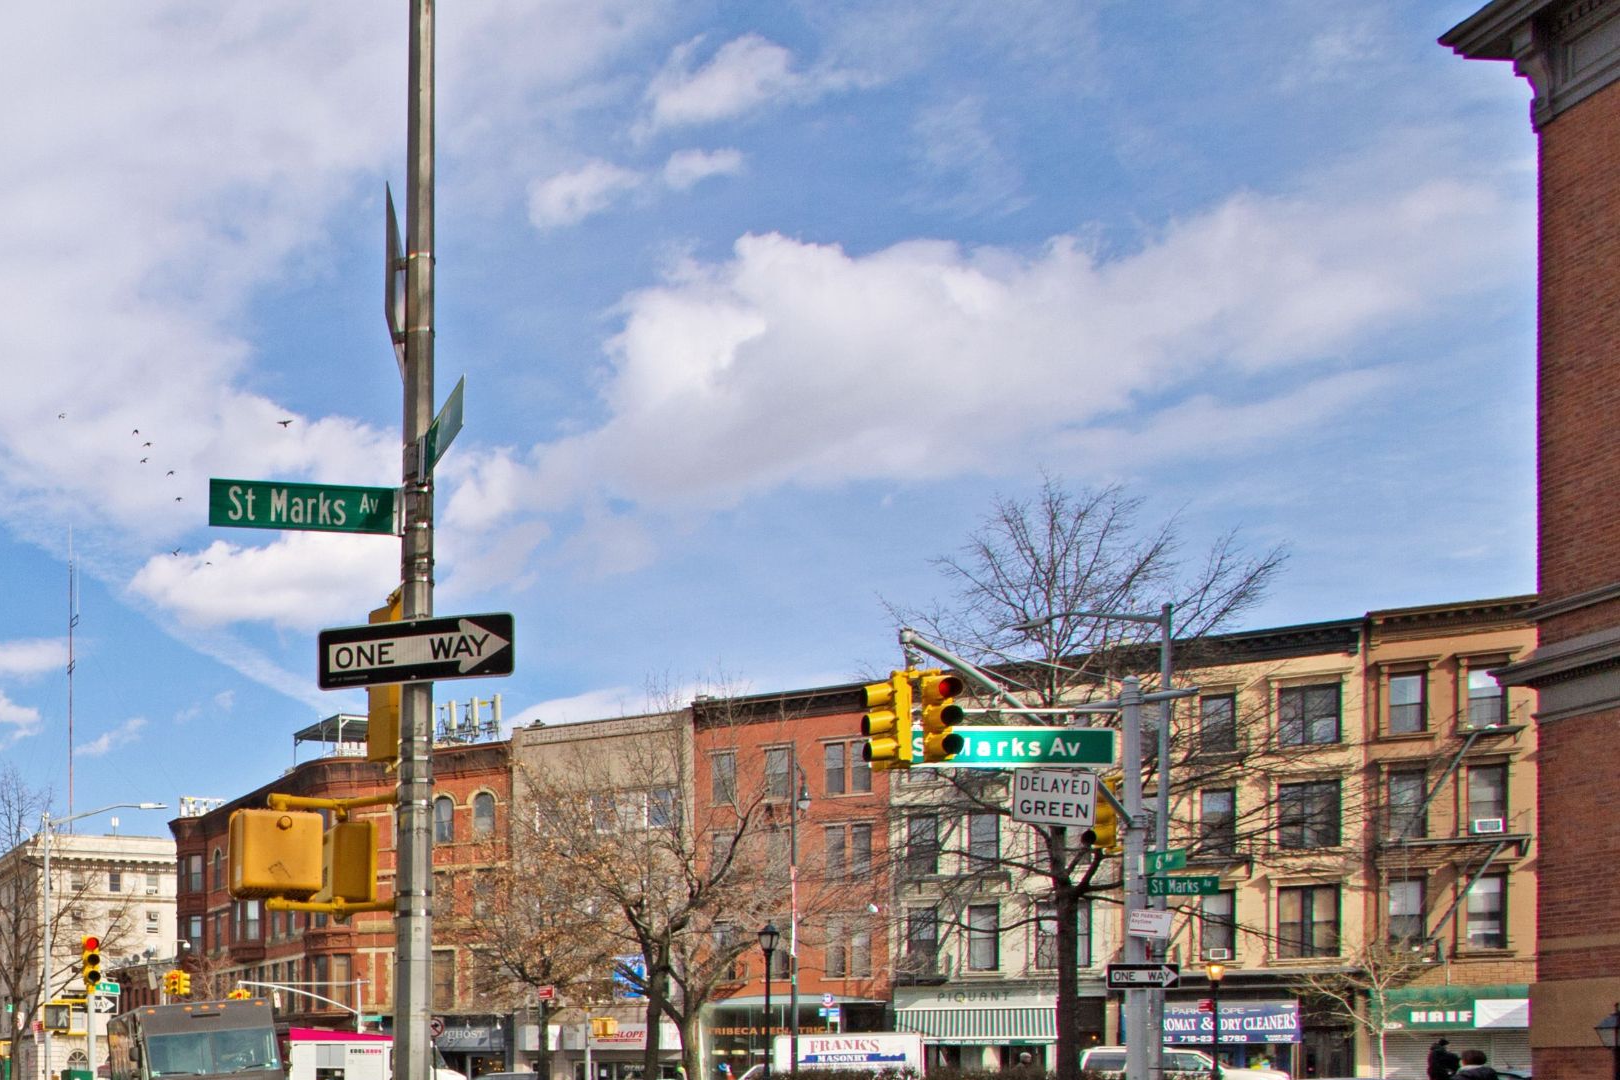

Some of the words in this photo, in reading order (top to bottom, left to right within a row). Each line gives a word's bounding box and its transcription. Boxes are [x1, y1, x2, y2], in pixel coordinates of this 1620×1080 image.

[228, 485, 256, 521] St
[270, 488, 347, 526] Marks
[359, 493, 379, 514] Av
[335, 642, 395, 669] ONE
[430, 633, 490, 660] WAY
[1048, 737, 1081, 757] Av
[1020, 775, 1091, 796] DELAYED
[1020, 800, 1089, 819] GREEN
[1155, 854, 1163, 870] 6
[1151, 879, 1164, 893] St
[1168, 879, 1200, 893] Marks
[1113, 971, 1136, 981] ONE
[1147, 971, 1170, 981] WAY
[937, 991, 1010, 1003] PIQUANT
[1200, 1016, 1214, 1030] &
[1220, 1018, 1241, 1031] DRY
[1243, 1012, 1297, 1031] CLEANERS
[707, 1026, 758, 1036] TRIBECA
[810, 1038, 881, 1053] FRANK'S
[817, 1054, 870, 1063] MASONRY
